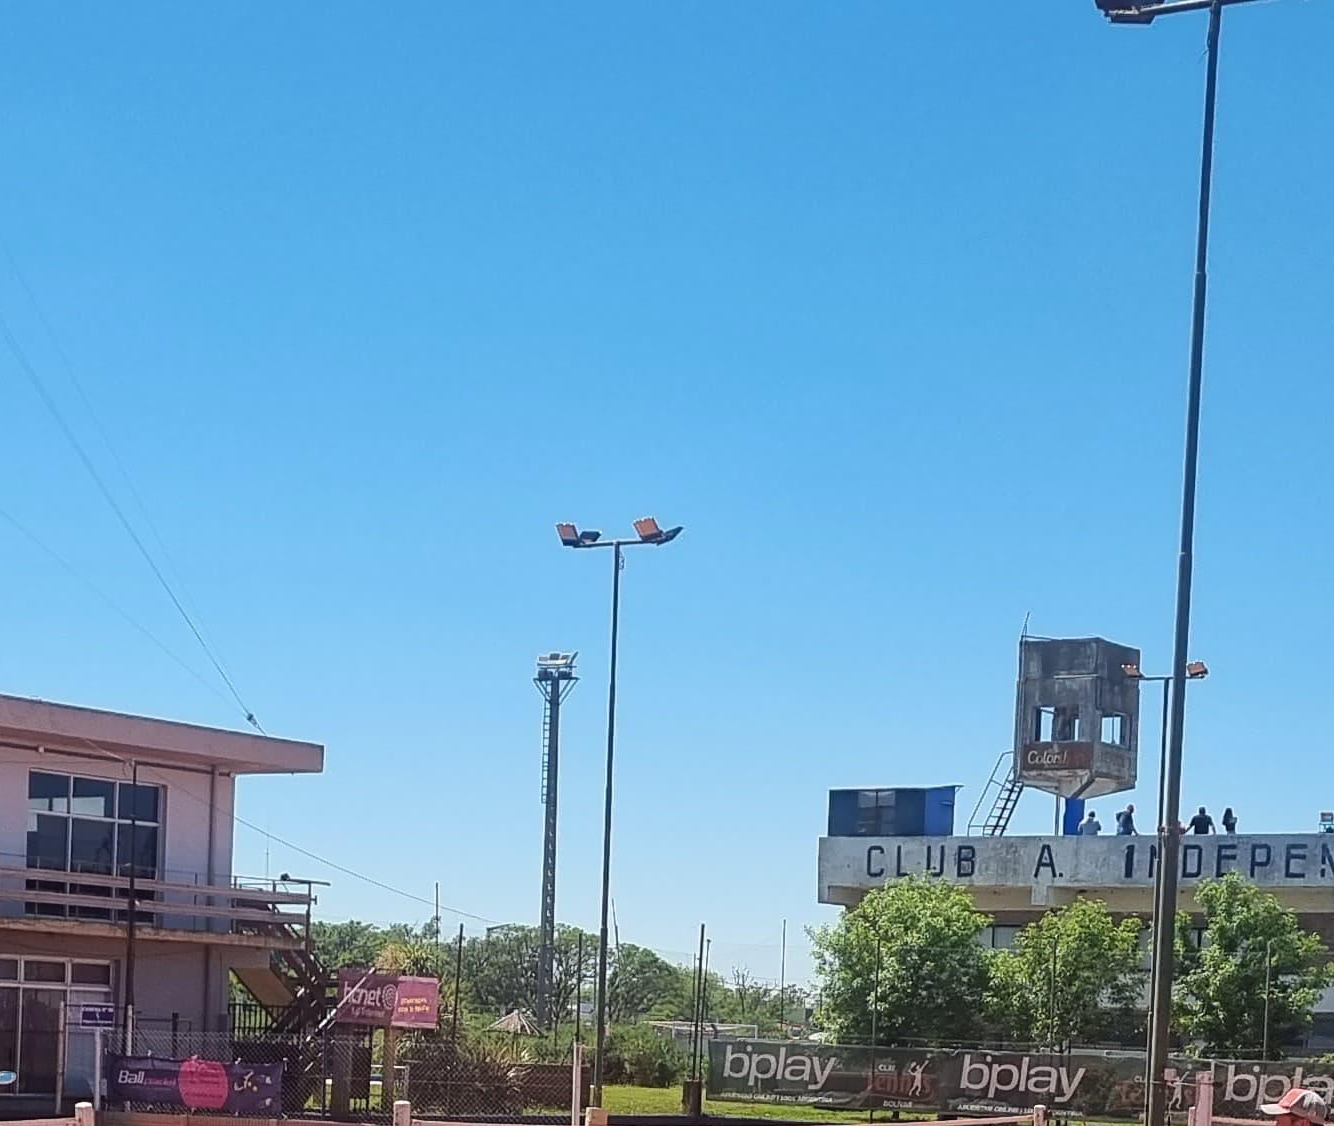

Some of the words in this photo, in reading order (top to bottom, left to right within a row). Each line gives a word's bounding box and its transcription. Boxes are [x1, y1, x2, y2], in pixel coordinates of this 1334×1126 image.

[866, 845, 975, 878] CLUB
[1033, 844, 1063, 878] A.
[118, 1069, 145, 1085] Ball
[723, 1045, 836, 1090] bplay
[960, 1054, 1086, 1103] bplay
